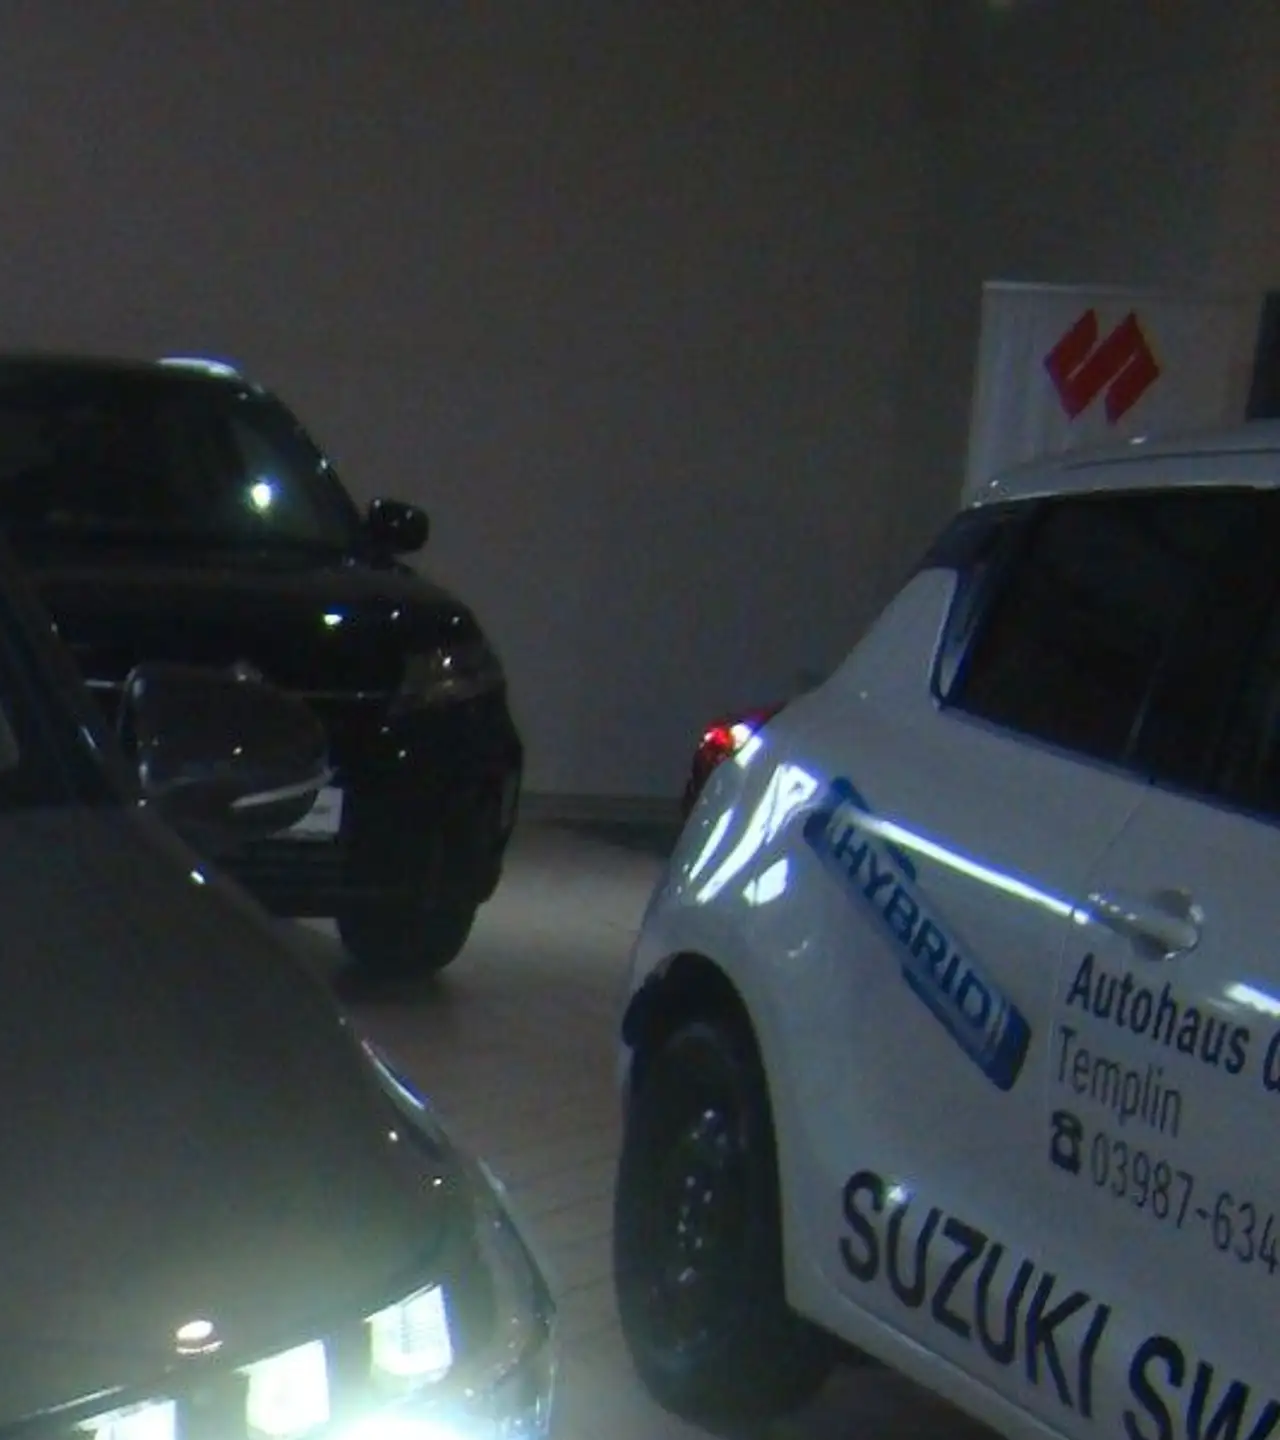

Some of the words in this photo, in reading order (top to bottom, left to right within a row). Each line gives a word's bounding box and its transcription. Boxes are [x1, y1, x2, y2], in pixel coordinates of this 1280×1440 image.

[833, 825, 992, 1029] HYBRID
[1058, 1025, 1183, 1138] Templin
[1066, 953, 1251, 1075] Autohaus
[1091, 1131, 1280, 1275] 03987-634
[840, 1170, 1112, 1418] SUZUKI
